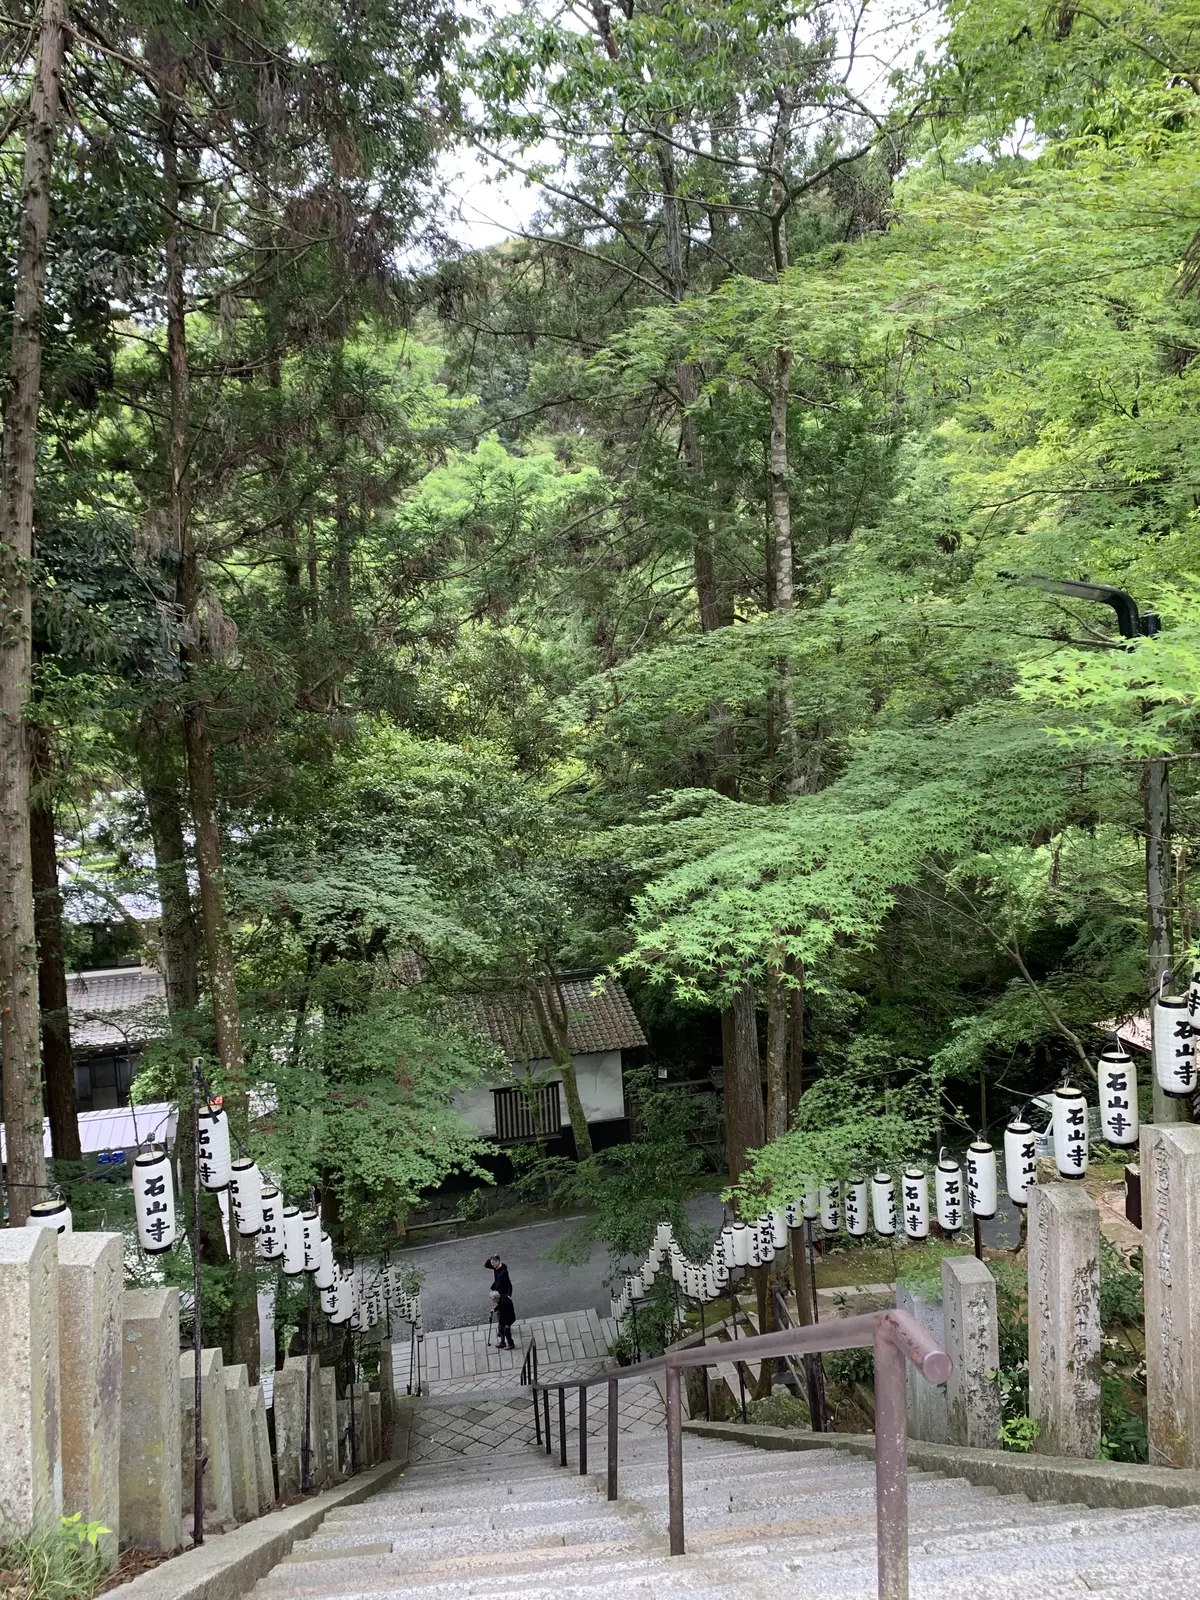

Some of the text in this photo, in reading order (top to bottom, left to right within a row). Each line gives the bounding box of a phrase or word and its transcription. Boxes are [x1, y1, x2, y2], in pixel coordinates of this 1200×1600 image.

[1173, 1020, 1196, 1086] 石山寺
[1106, 1072, 1131, 1137] 石山寺
[198, 1128, 216, 1183] 石山寺
[1066, 1107, 1087, 1168] 石山寺
[230, 1180, 245, 1229] 石山寺
[828, 1186, 840, 1226] 石山寺
[945, 1180, 961, 1226] 石山寺
[966, 1159, 980, 1209] 石山寺
[144, 1175, 170, 1243] 石山寺
[262, 1207, 278, 1254] 石山寺
[846, 1190, 859, 1230] 石山寺
[905, 1186, 922, 1232] 石山寺
[716, 1249, 726, 1277] 石山寺
[760, 1226, 771, 1258] 石山寺
